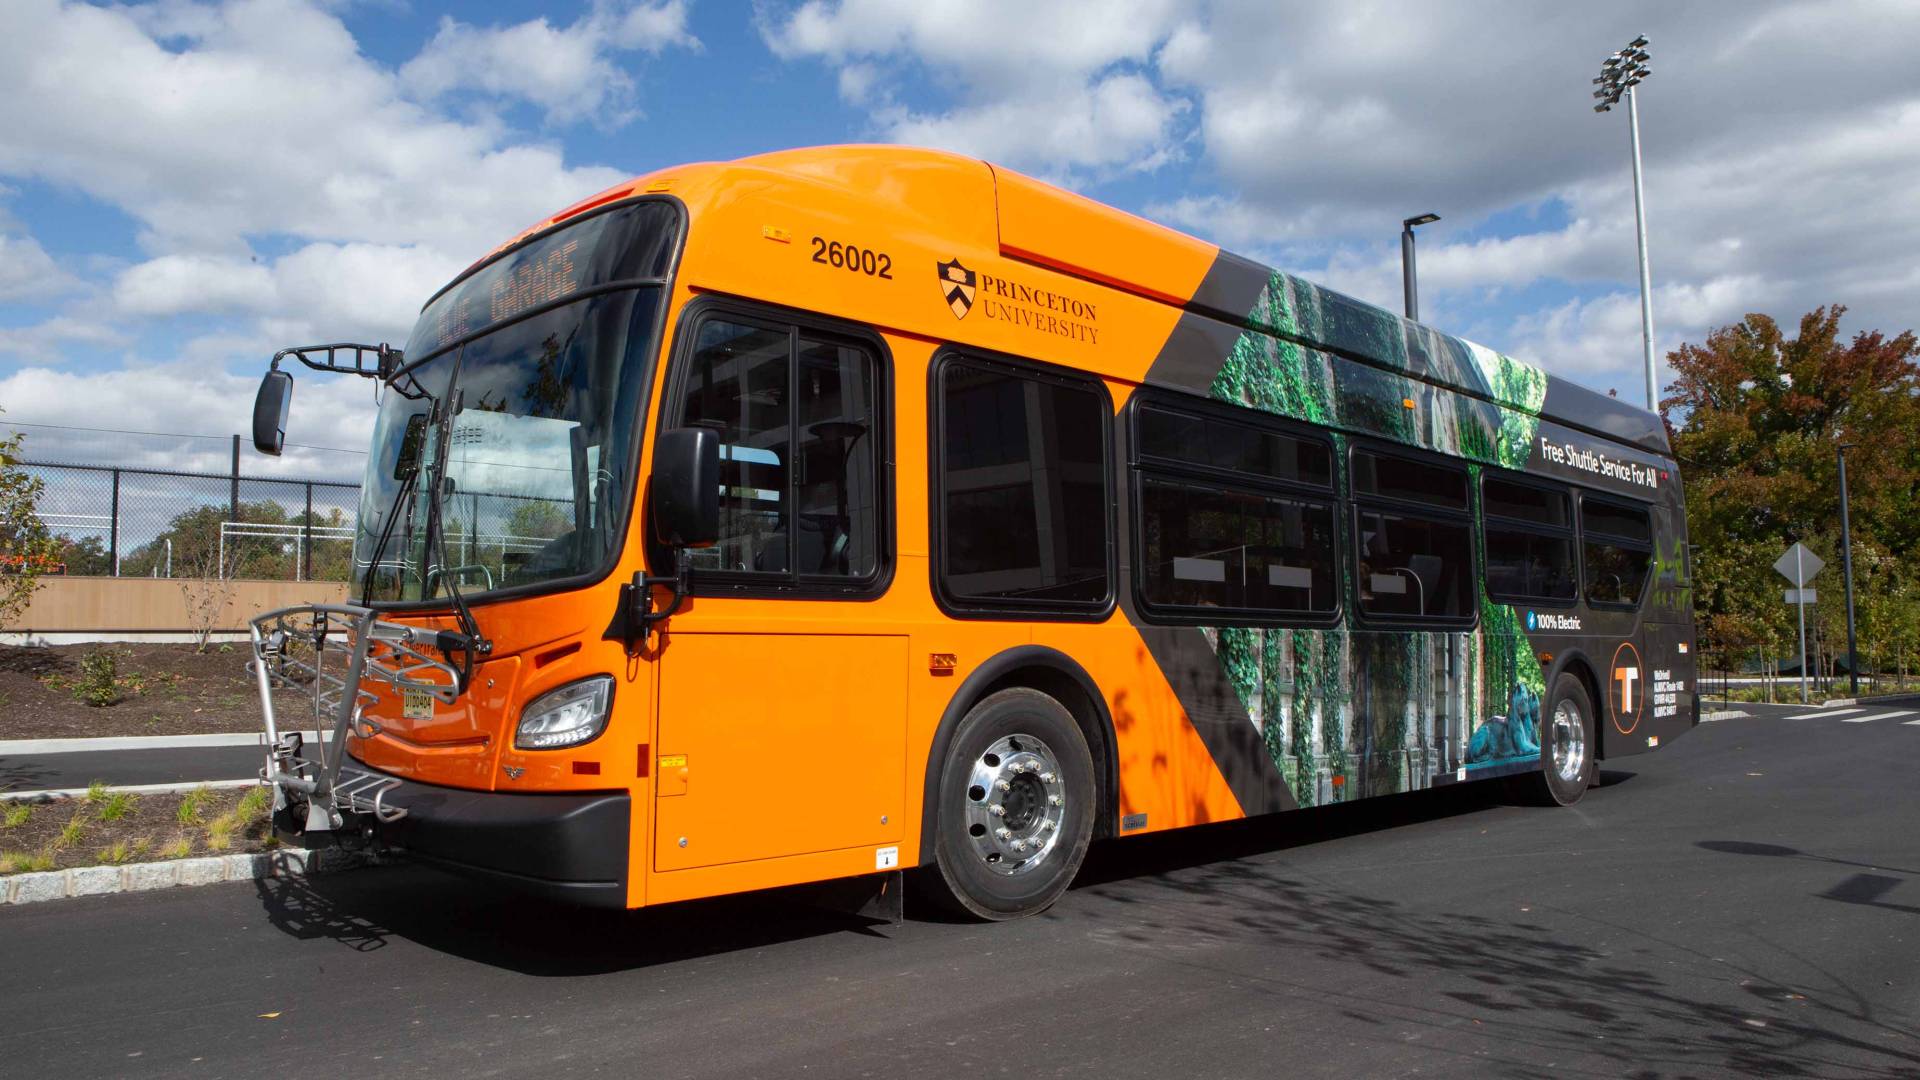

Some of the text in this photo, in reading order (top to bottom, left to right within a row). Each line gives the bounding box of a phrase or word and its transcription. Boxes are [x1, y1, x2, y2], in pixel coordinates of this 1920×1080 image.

[490, 239, 578, 322] GARAGE
[811, 236, 893, 280] 26002
[982, 274, 1097, 321] PRINCETON
[984, 300, 1099, 345] UNIVERSITY
[1541, 437, 1657, 488] Free Shuttle Service For All
[1537, 614, 1581, 631] 100% Electric
[1615, 667, 1638, 714] T
